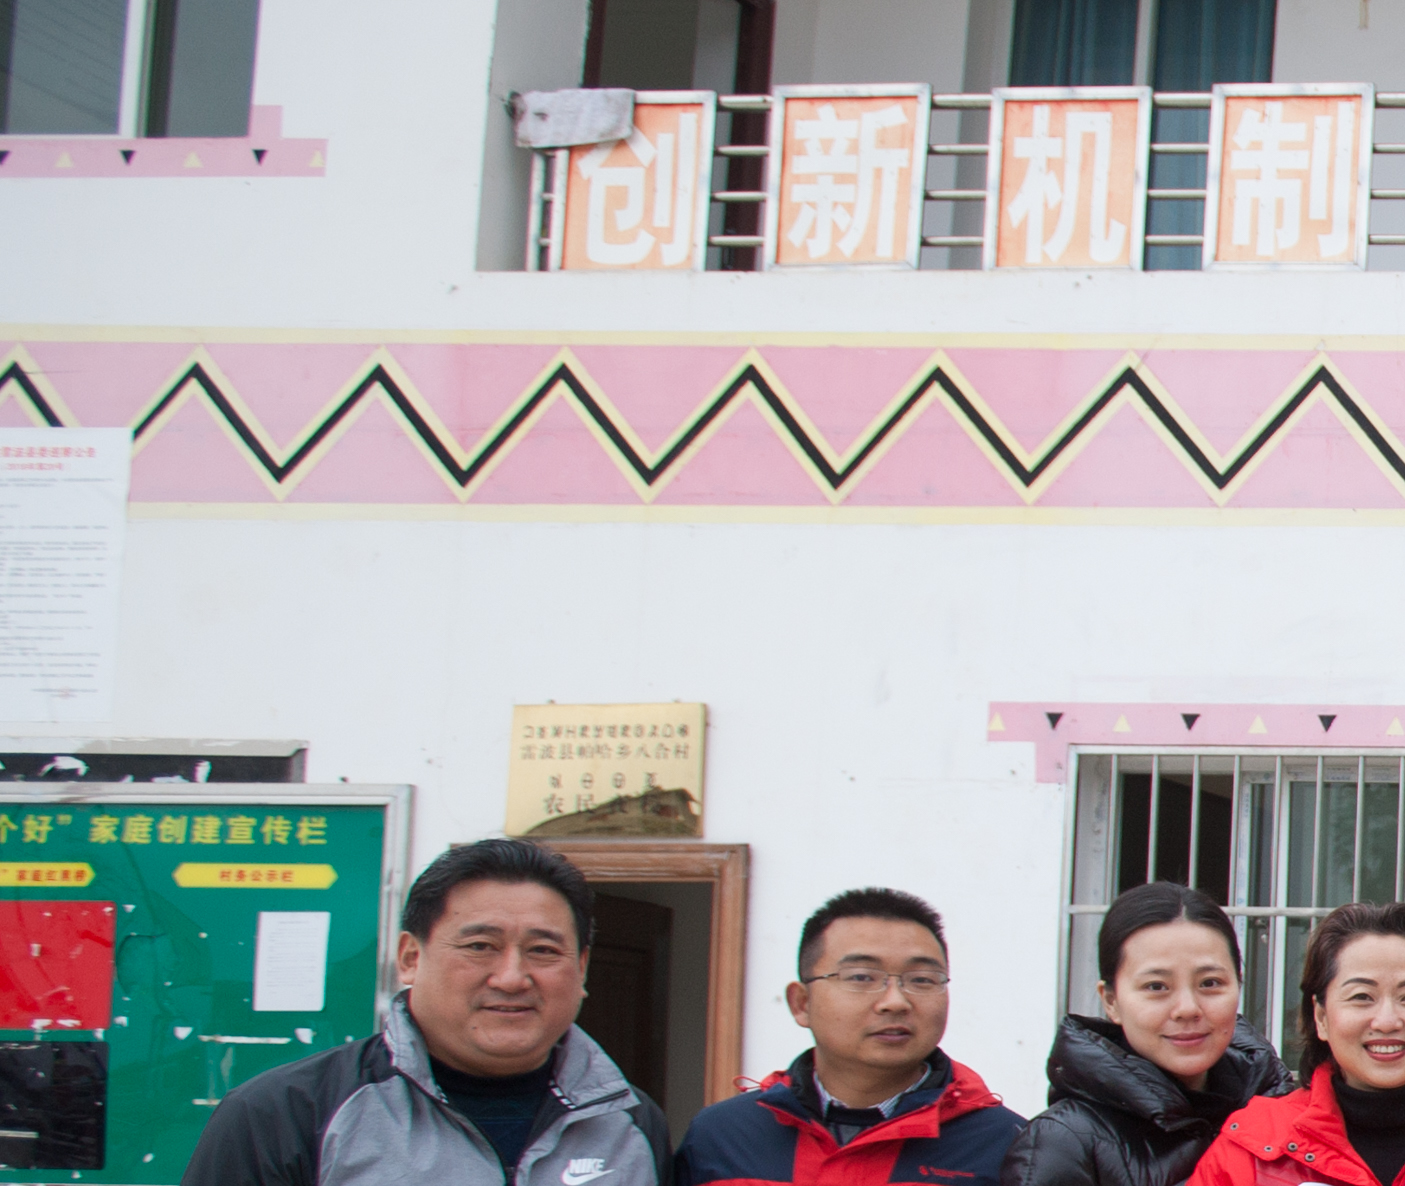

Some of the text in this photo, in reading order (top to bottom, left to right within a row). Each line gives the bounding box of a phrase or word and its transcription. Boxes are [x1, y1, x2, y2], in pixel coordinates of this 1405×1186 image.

[520, 743, 690, 761] 雷波县帕哈乡八合村
[219, 869, 295, 883] 村务公示栏
[569, 1158, 606, 1174] NIKE
